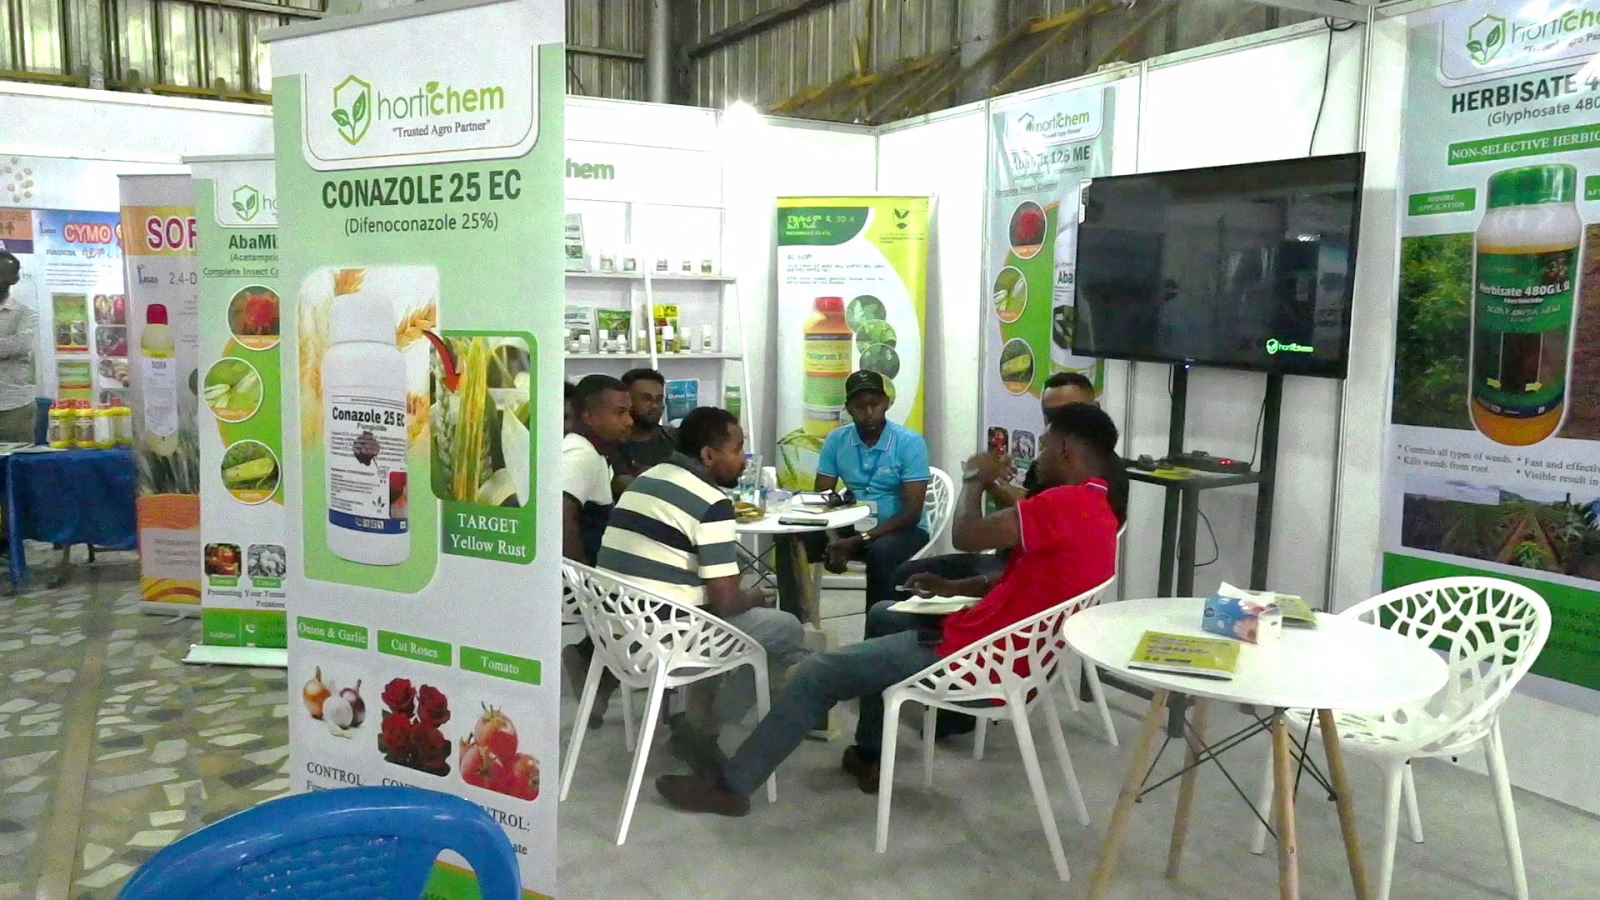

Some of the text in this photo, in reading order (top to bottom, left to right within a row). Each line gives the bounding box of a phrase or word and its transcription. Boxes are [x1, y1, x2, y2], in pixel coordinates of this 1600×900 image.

[378, 82, 505, 120] hortichem
[1452, 74, 1577, 114] HERBISATE
[1488, 102, 1570, 127] (Glyphosate
[393, 119, 491, 138] "Trusted Agro Partner"
[1073, 146, 1090, 161] ME
[1452, 138, 1549, 160] NON-SELECTIVE
[322, 168, 522, 208] CONAZOLE 25 EC
[64, 223, 112, 244] CYMO
[345, 211, 498, 236] (Difenoconazole 25%)
[228, 234, 279, 249] AbaMi
[203, 267, 240, 277] Complete
[243, 267, 268, 276] Insect
[332, 406, 382, 424] Conazole
[384, 411, 395, 426] 25
[1404, 444, 1436, 457] Controls
[1437, 448, 1449, 457] all
[1450, 450, 1471, 461] types
[1473, 451, 1482, 461] of
[1403, 456, 1422, 466] Kills
[1423, 459, 1448, 469] weeds
[1450, 461, 1470, 472] from
[1524, 457, 1543, 468] Fast
[1546, 461, 1563, 470] and
[1524, 469, 1599, 487] Visible result in
[457, 512, 519, 534] TARGET
[450, 533, 526, 557] Yellow Rust
[299, 622, 367, 644] Onion & Garlic
[391, 638, 439, 659] Cut Roses
[480, 655, 519, 675] Tomato
